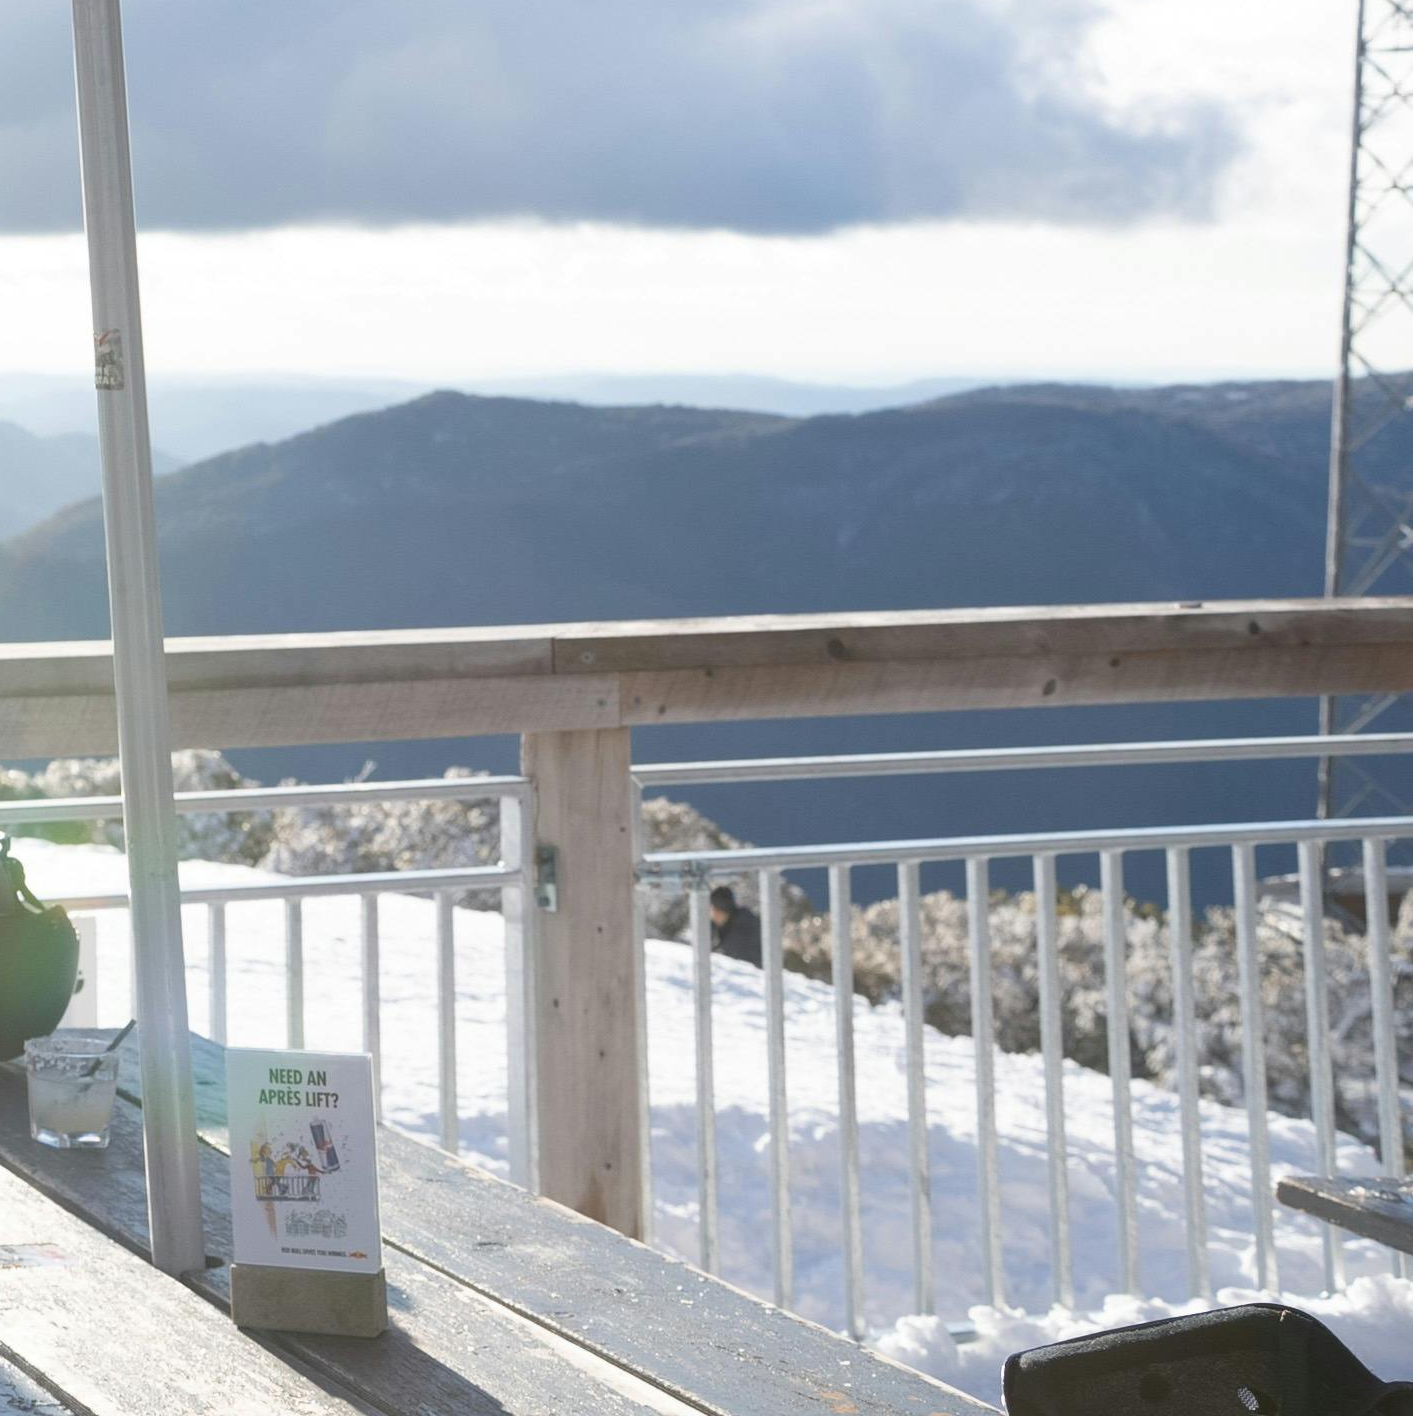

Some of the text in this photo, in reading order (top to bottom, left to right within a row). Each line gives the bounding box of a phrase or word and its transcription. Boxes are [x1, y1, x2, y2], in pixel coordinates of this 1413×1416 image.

[269, 1068, 327, 1086] NEED AN
[259, 1086, 339, 1108] APRÈS LIFT?
